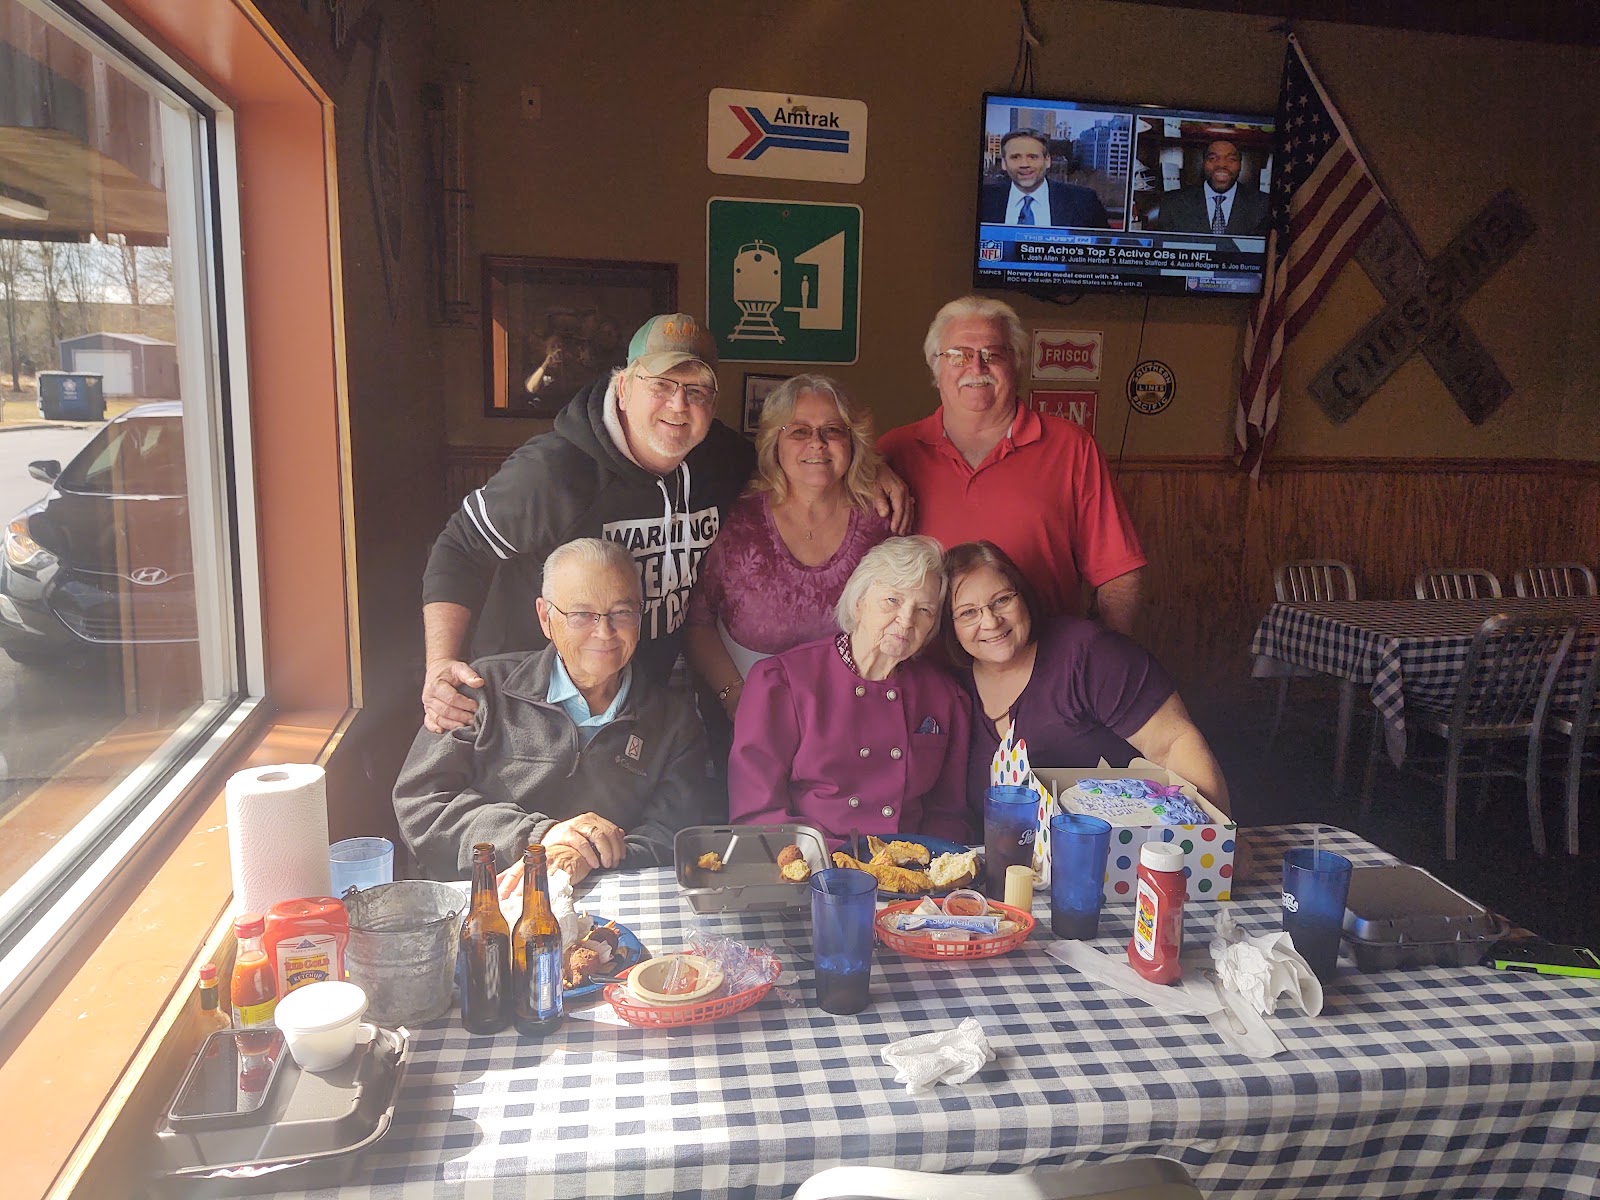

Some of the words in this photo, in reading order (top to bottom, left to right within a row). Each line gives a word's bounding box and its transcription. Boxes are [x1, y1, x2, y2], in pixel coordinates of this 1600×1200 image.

[773, 107, 840, 129] Amtrak
[981, 249, 1000, 259] NFL
[1020, 244, 1045, 254] Sam
[1047, 245, 1084, 256] Acho's
[1087, 247, 1106, 258] Top
[1108, 248, 1116, 257] 5
[1118, 249, 1151, 258] Active
[1153, 250, 1176, 260] QBs
[1191, 252, 1213, 261] NFL
[1195, 262, 1219, 270] Rodgers
[1045, 348, 1089, 363] FRISCO
[1133, 365, 1172, 384] SOUTHERN
[1132, 395, 1168, 411] PACIFIC
[605, 515, 717, 552] WARNING:
